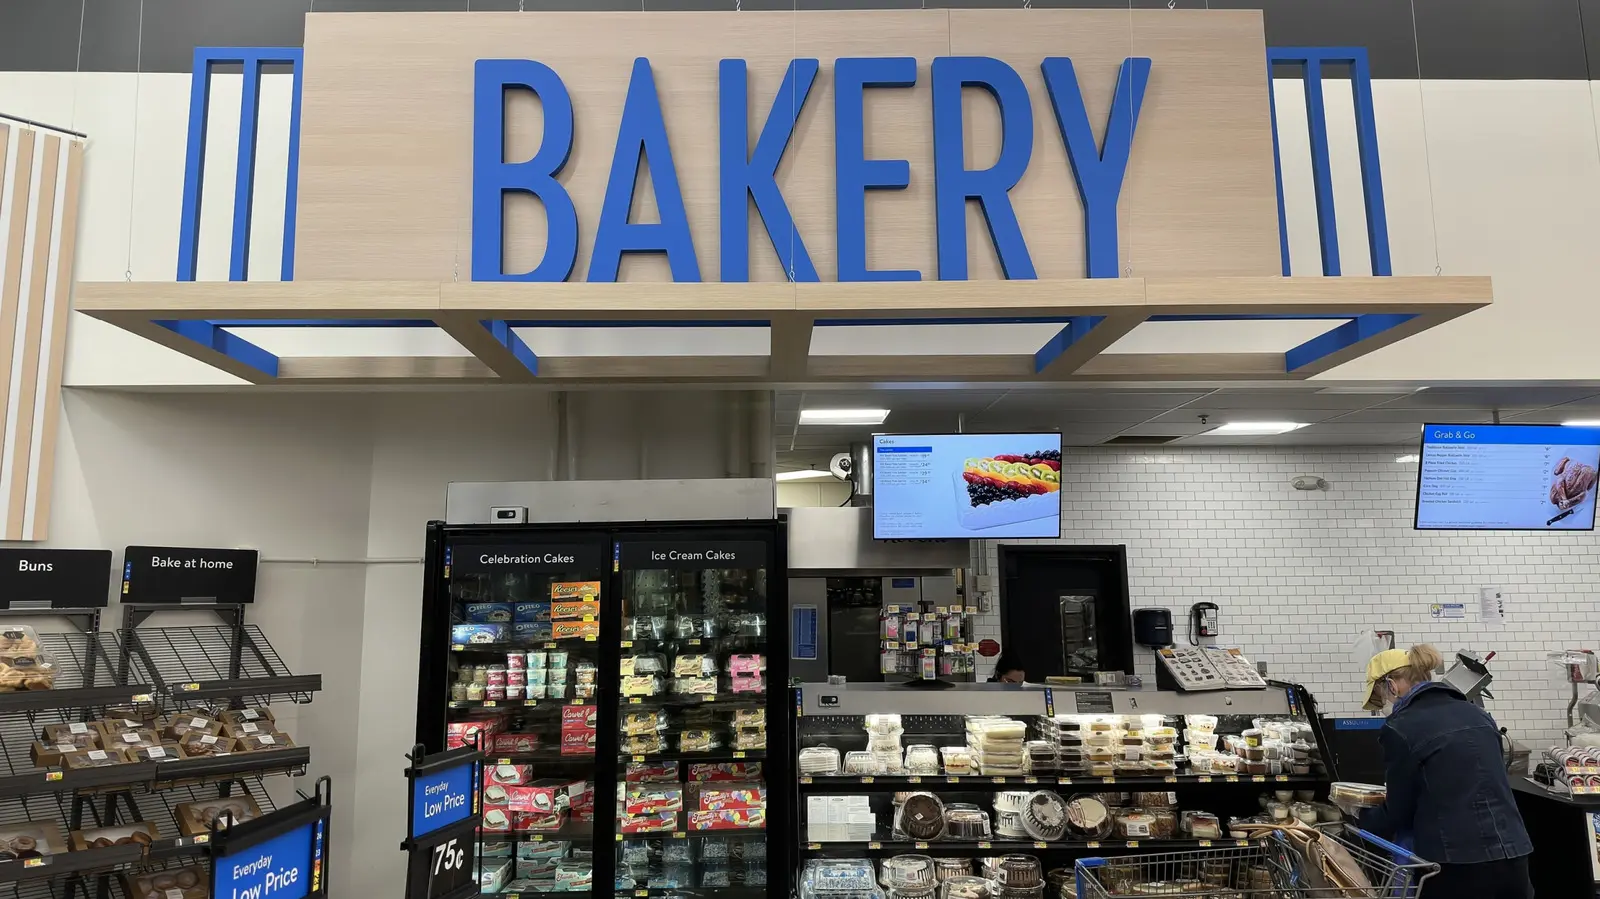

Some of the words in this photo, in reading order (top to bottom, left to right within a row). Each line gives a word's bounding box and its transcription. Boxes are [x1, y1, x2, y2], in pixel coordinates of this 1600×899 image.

[471, 56, 1151, 282] BAKERY
[1434, 430, 1453, 439] Grab
[1455, 431, 1461, 439] &
[1463, 431, 1476, 439] Go
[480, 554, 541, 564] Celebration
[543, 553, 575, 563] Cakes
[651, 551, 666, 560] Ice
[669, 551, 703, 560] Cream
[705, 550, 736, 560] Cakes
[19, 560, 53, 572] Buns
[152, 556, 181, 568] Bake
[184, 558, 197, 568] at
[200, 558, 234, 569] home
[517, 603, 540, 611] OREO
[563, 709, 583, 718] Carvel
[425, 781, 449, 796] Everyday
[424, 801, 442, 818] Low
[444, 793, 465, 811] Price
[434, 838, 464, 876] 75¢
[233, 855, 272, 880] Everyday
[232, 884, 261, 899] Low
[265, 867, 298, 895] Price
